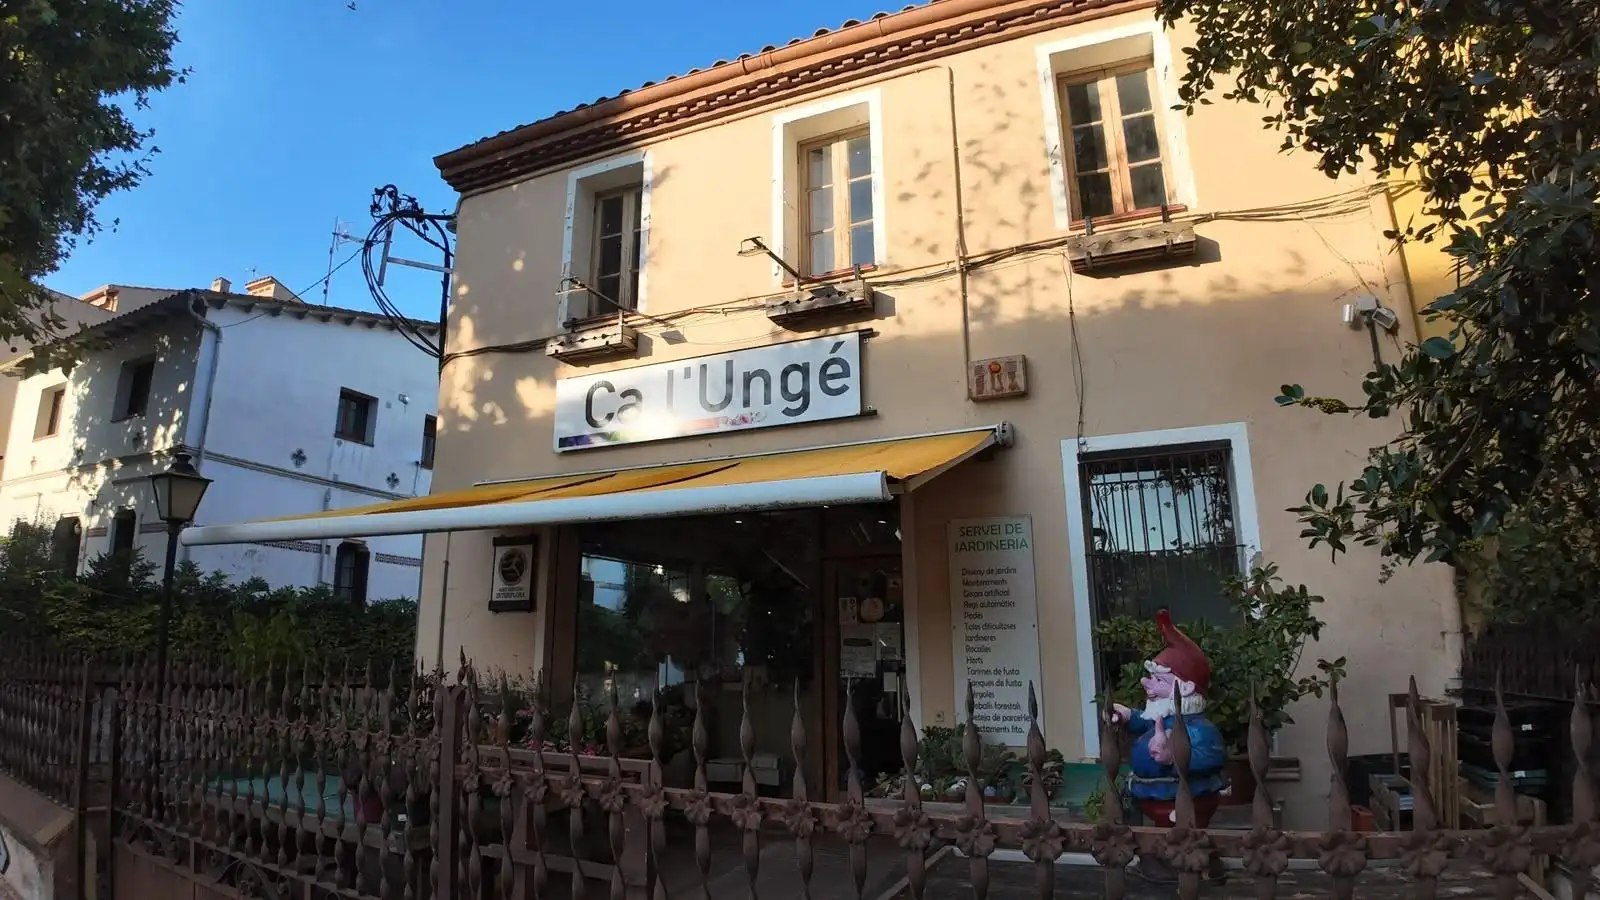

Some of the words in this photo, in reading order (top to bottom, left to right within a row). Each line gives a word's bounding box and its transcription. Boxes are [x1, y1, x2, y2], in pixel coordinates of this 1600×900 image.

[585, 379, 643, 428] Ca
[666, 340, 851, 417] l'Ungé
[959, 525, 1001, 537] SERVEI
[1005, 523, 1022, 535] DE
[955, 538, 1029, 553] JARDINERIA
[986, 567, 994, 575] de
[995, 566, 1017, 576] jardins
[963, 590, 983, 598] Gespa
[984, 588, 1010, 597] artificial
[980, 599, 1016, 608] automàtics
[964, 611, 983, 620] Podes
[964, 622, 981, 631] Tales
[982, 622, 1016, 631] dificultoses
[965, 633, 997, 642] Jardineres
[966, 645, 991, 653] Rocalles
[966, 656, 984, 664] Horts
[967, 667, 992, 675] Tarimes
[993, 667, 1002, 675] de
[1003, 666, 1020, 675] fusta
[996, 678, 1004, 687] de
[1005, 678, 1023, 687] fusta
[994, 701, 1020, 710] forestals
[974, 714, 990, 723] eteja
[992, 713, 1001, 722] de
[1011, 724, 1025, 734] fito.
